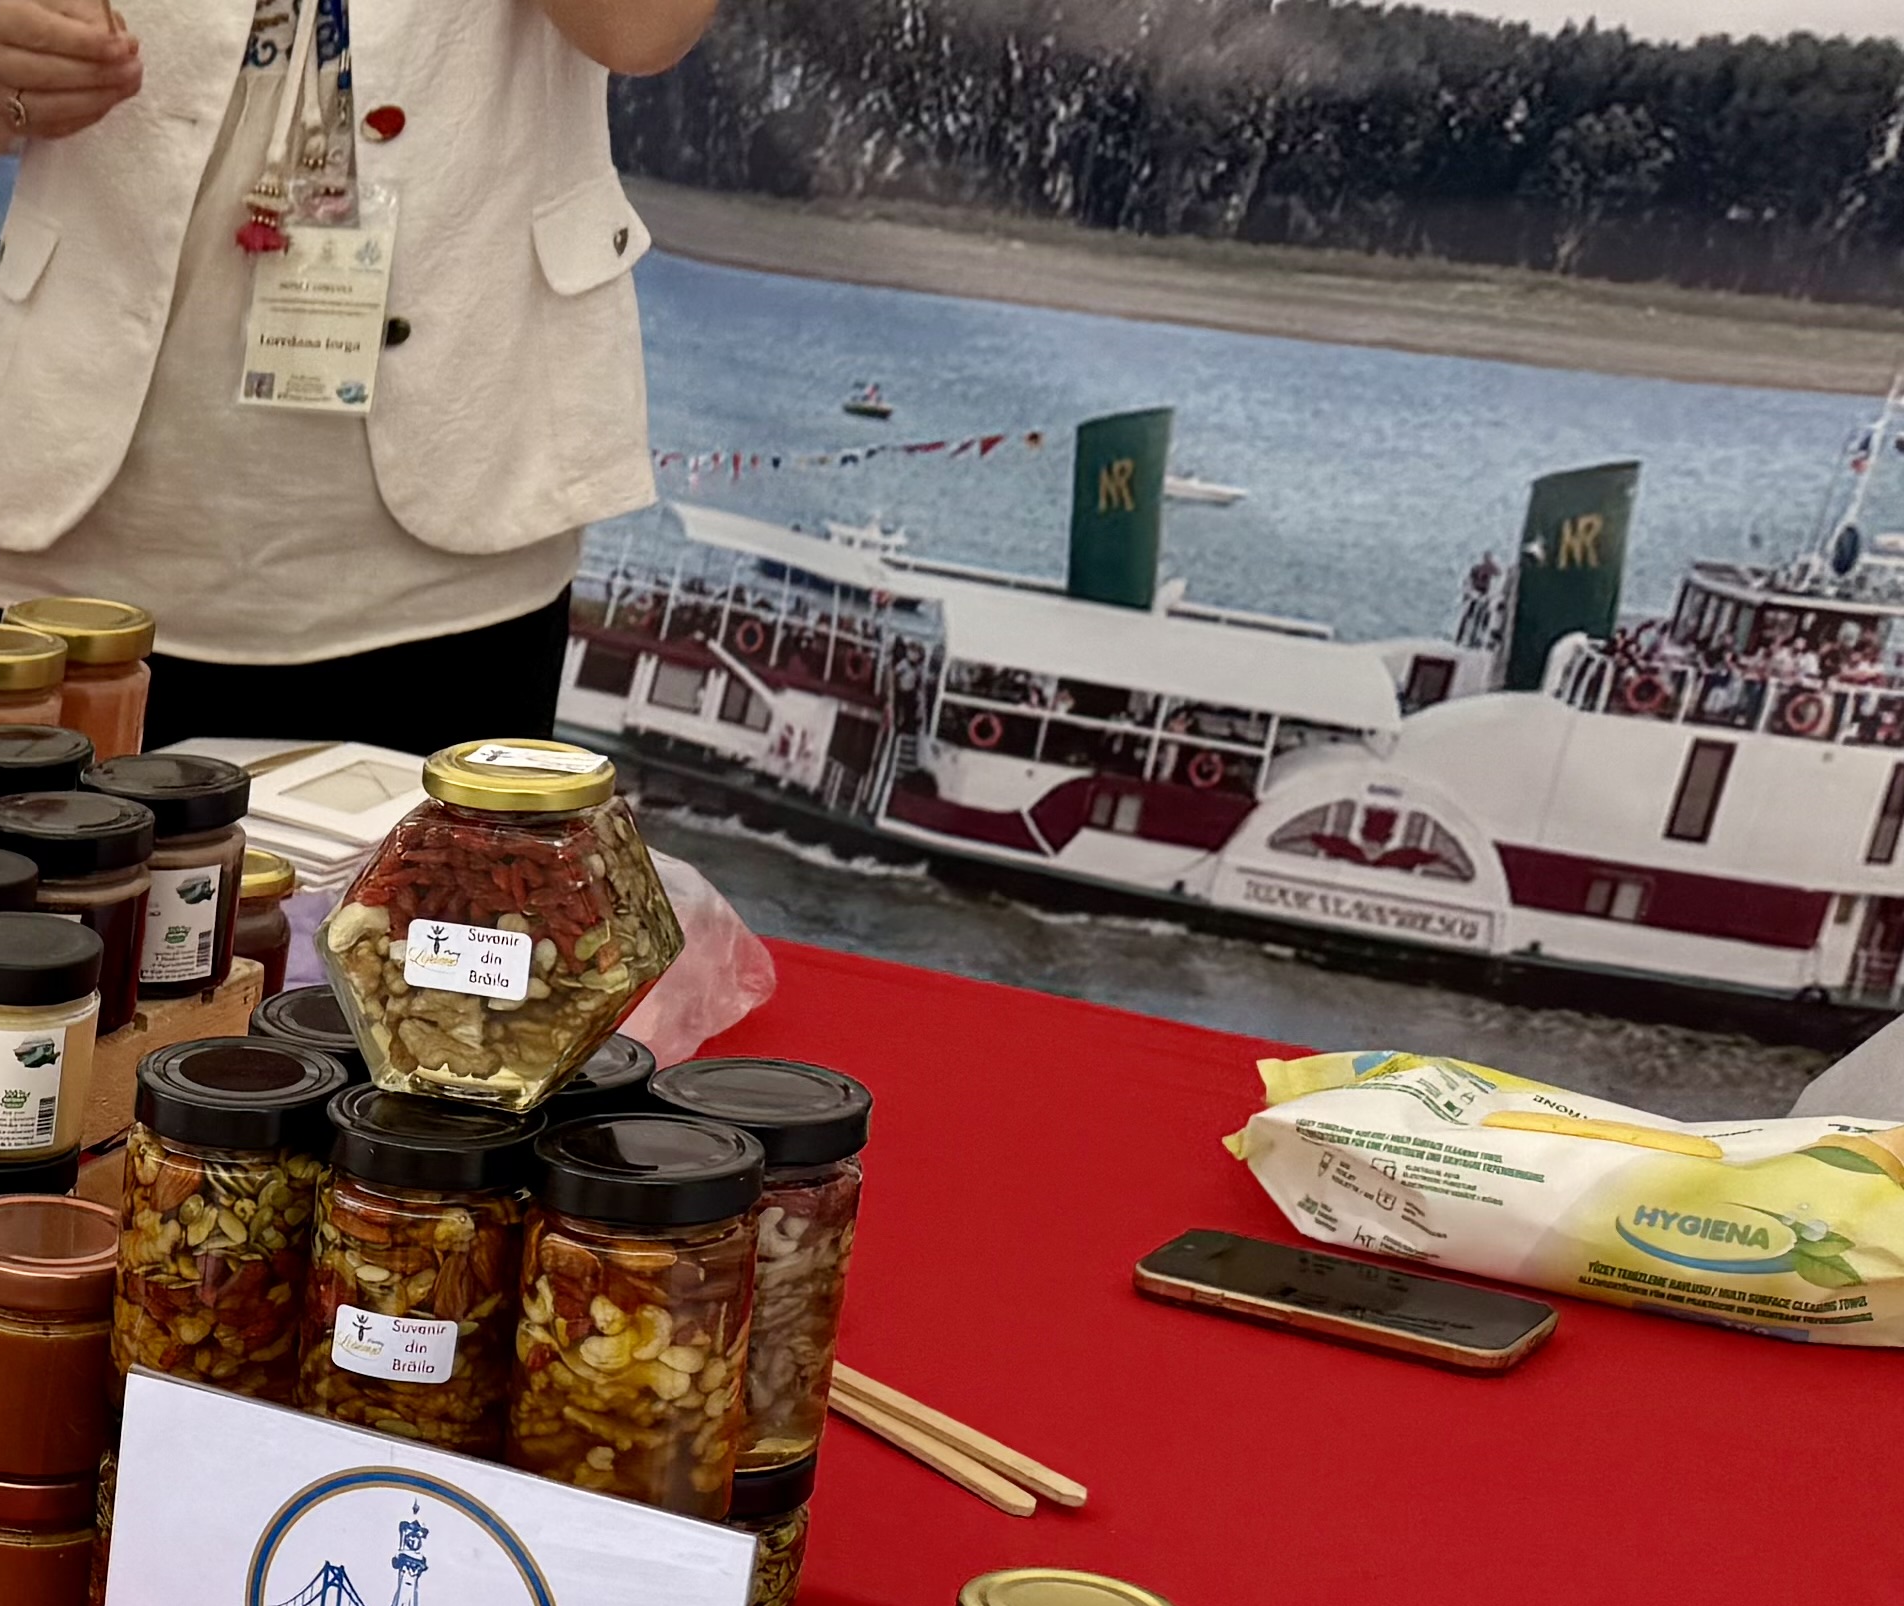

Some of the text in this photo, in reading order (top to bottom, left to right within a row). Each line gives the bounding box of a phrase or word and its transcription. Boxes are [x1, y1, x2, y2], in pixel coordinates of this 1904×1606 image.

[480, 952, 502, 966] din
[1632, 1204, 1770, 1251] HYGIENA
[404, 1340, 428, 1357] din
